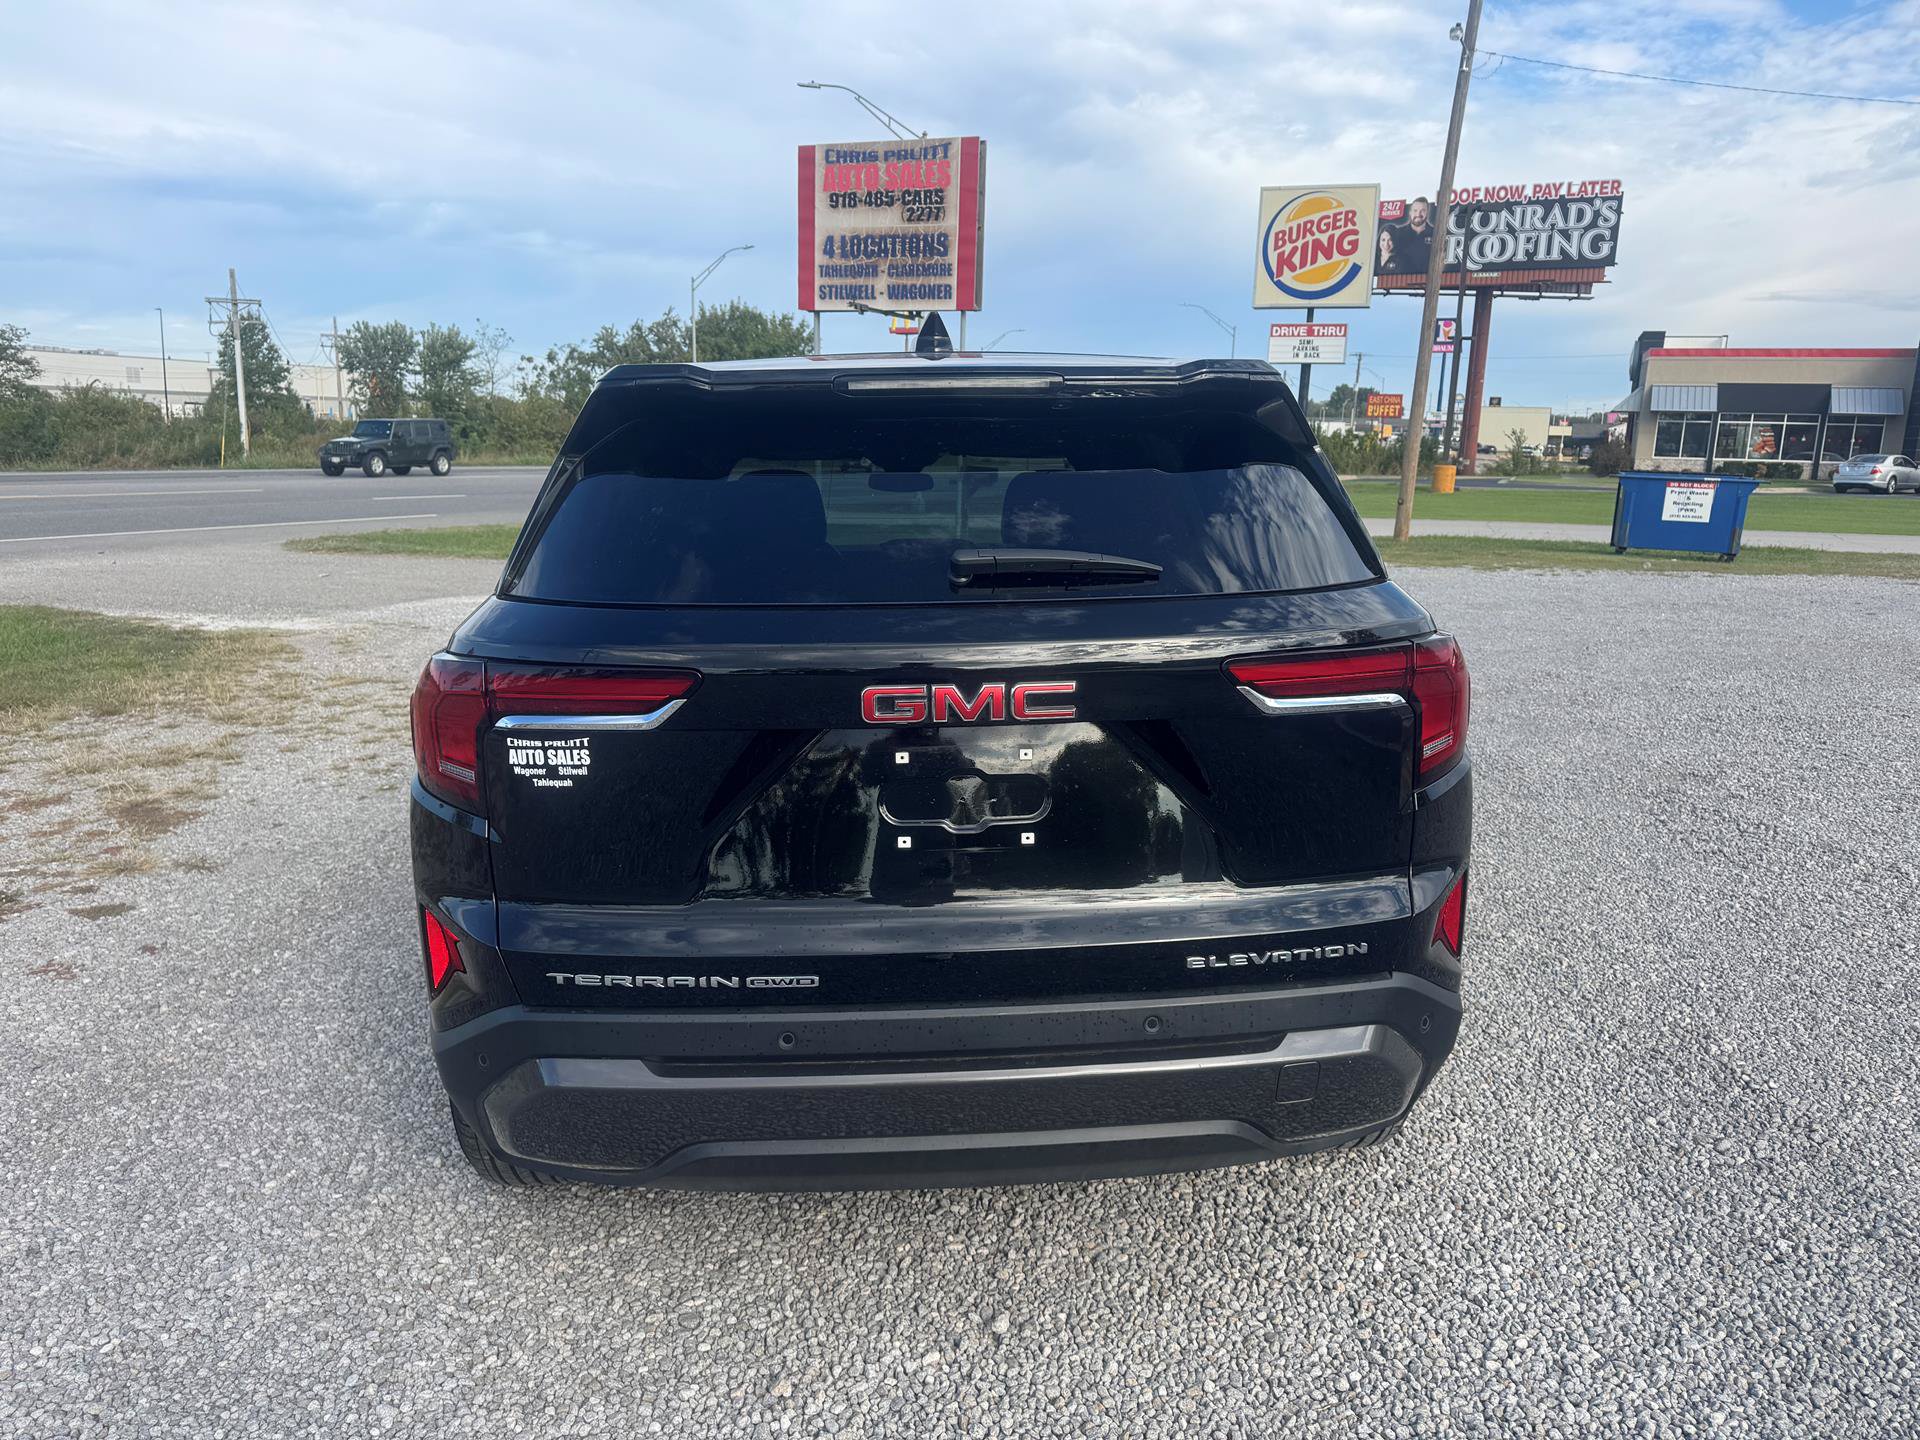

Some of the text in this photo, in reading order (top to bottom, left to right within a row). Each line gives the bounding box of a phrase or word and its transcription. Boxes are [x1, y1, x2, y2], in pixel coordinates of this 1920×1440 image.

[825, 143, 951, 164] CHRIS PRUITT
[823, 160, 951, 192] AUTO SALES
[829, 189, 944, 209] 918-485-CARS
[1437, 180, 1622, 205] OOF NOW, PAY LATER
[901, 206, 945, 223] (2277)
[1383, 202, 1401, 210] 24/7
[1448, 198, 1619, 234] CONRAD'S
[1274, 209, 1357, 251] BURGER
[823, 232, 949, 259] 4 LOCATIONS
[1276, 228, 1360, 278] KING
[1445, 227, 1613, 271] ROOFING
[819, 264, 878, 279] TAHLEQUAH
[887, 263, 952, 278] CLAREMORE
[819, 284, 877, 300] STILWELL
[887, 283, 952, 300] WAGONER
[1272, 326, 1345, 336] DRIVE THRU
[1369, 395, 1401, 404] EAST CHINA
[1368, 405, 1401, 417] BUFFET
[861, 681, 1077, 724] GMC
[506, 737, 590, 747] CHRIS PRUITT
[508, 749, 591, 765] AUTO SALES
[513, 766, 588, 777] Wagoner Stilwell
[532, 778, 573, 788] Tahlequah
[1185, 942, 1368, 969] ELEVATION
[546, 972, 740, 989] TERRAIN
